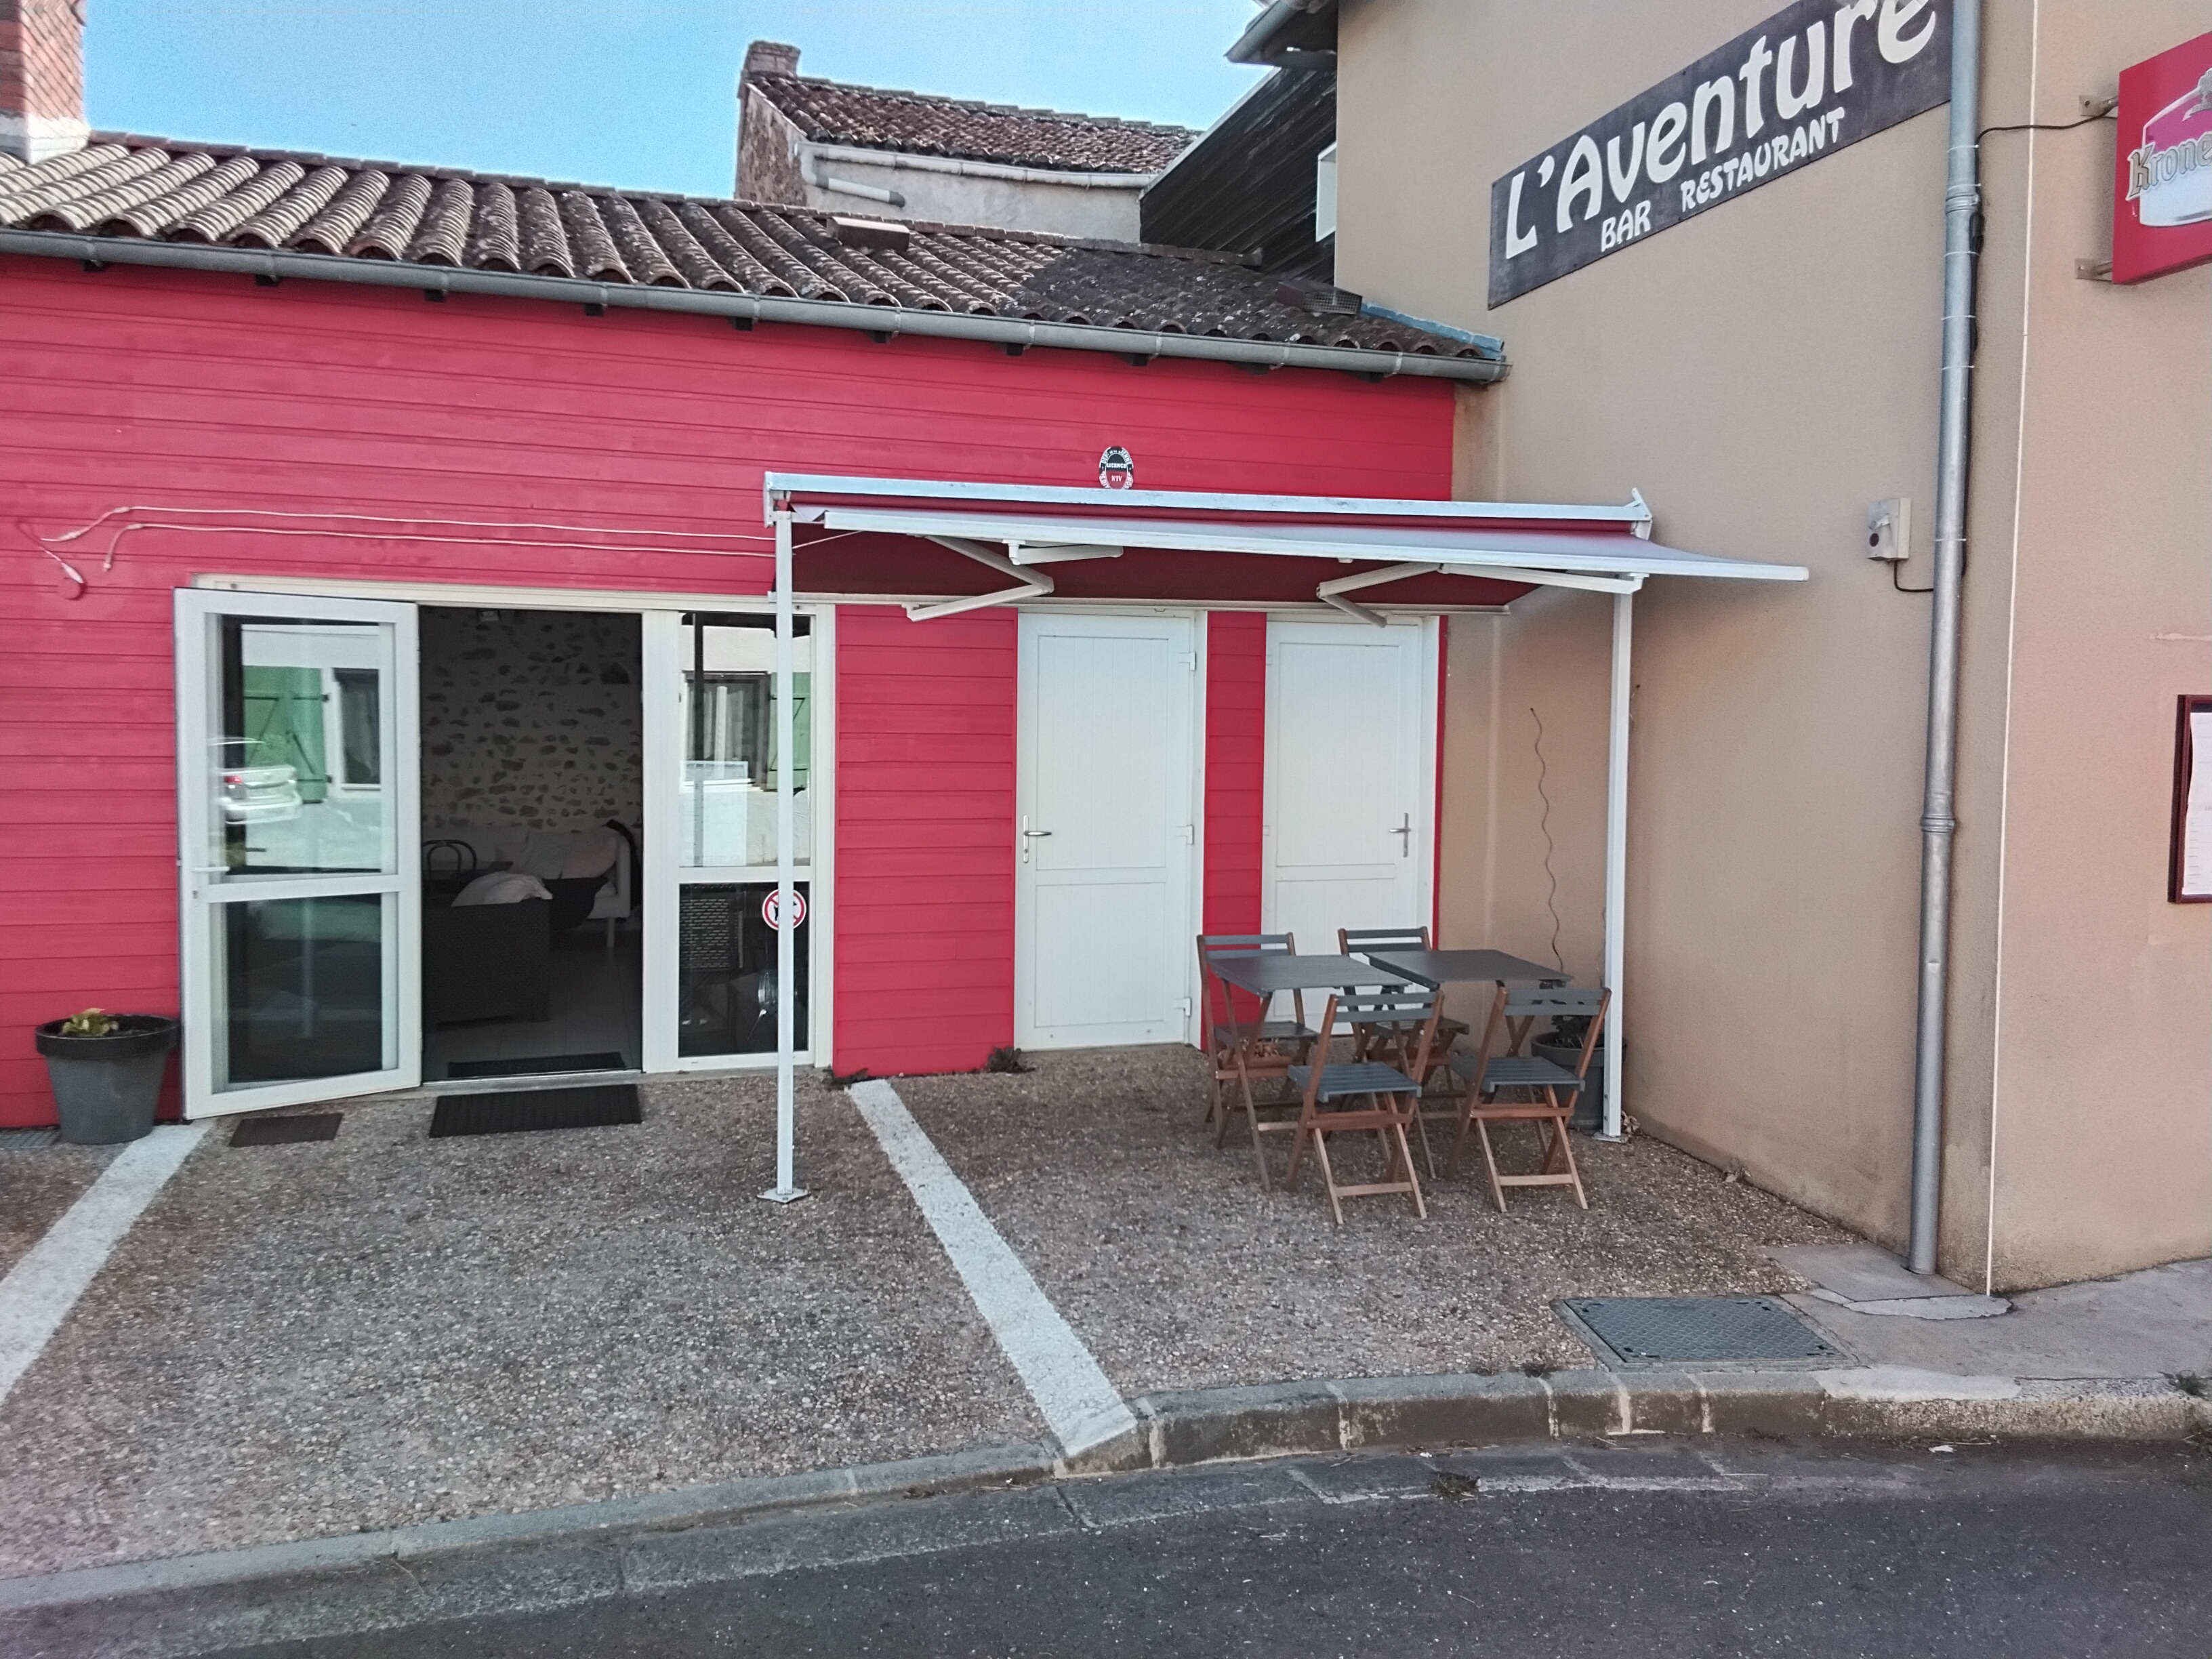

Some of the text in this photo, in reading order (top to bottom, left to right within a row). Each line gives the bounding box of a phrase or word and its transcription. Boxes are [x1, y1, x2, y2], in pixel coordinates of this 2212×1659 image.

[1505, 0, 1936, 260] L'Aventure
[1600, 106, 1845, 252] BAR RESTAURANT
